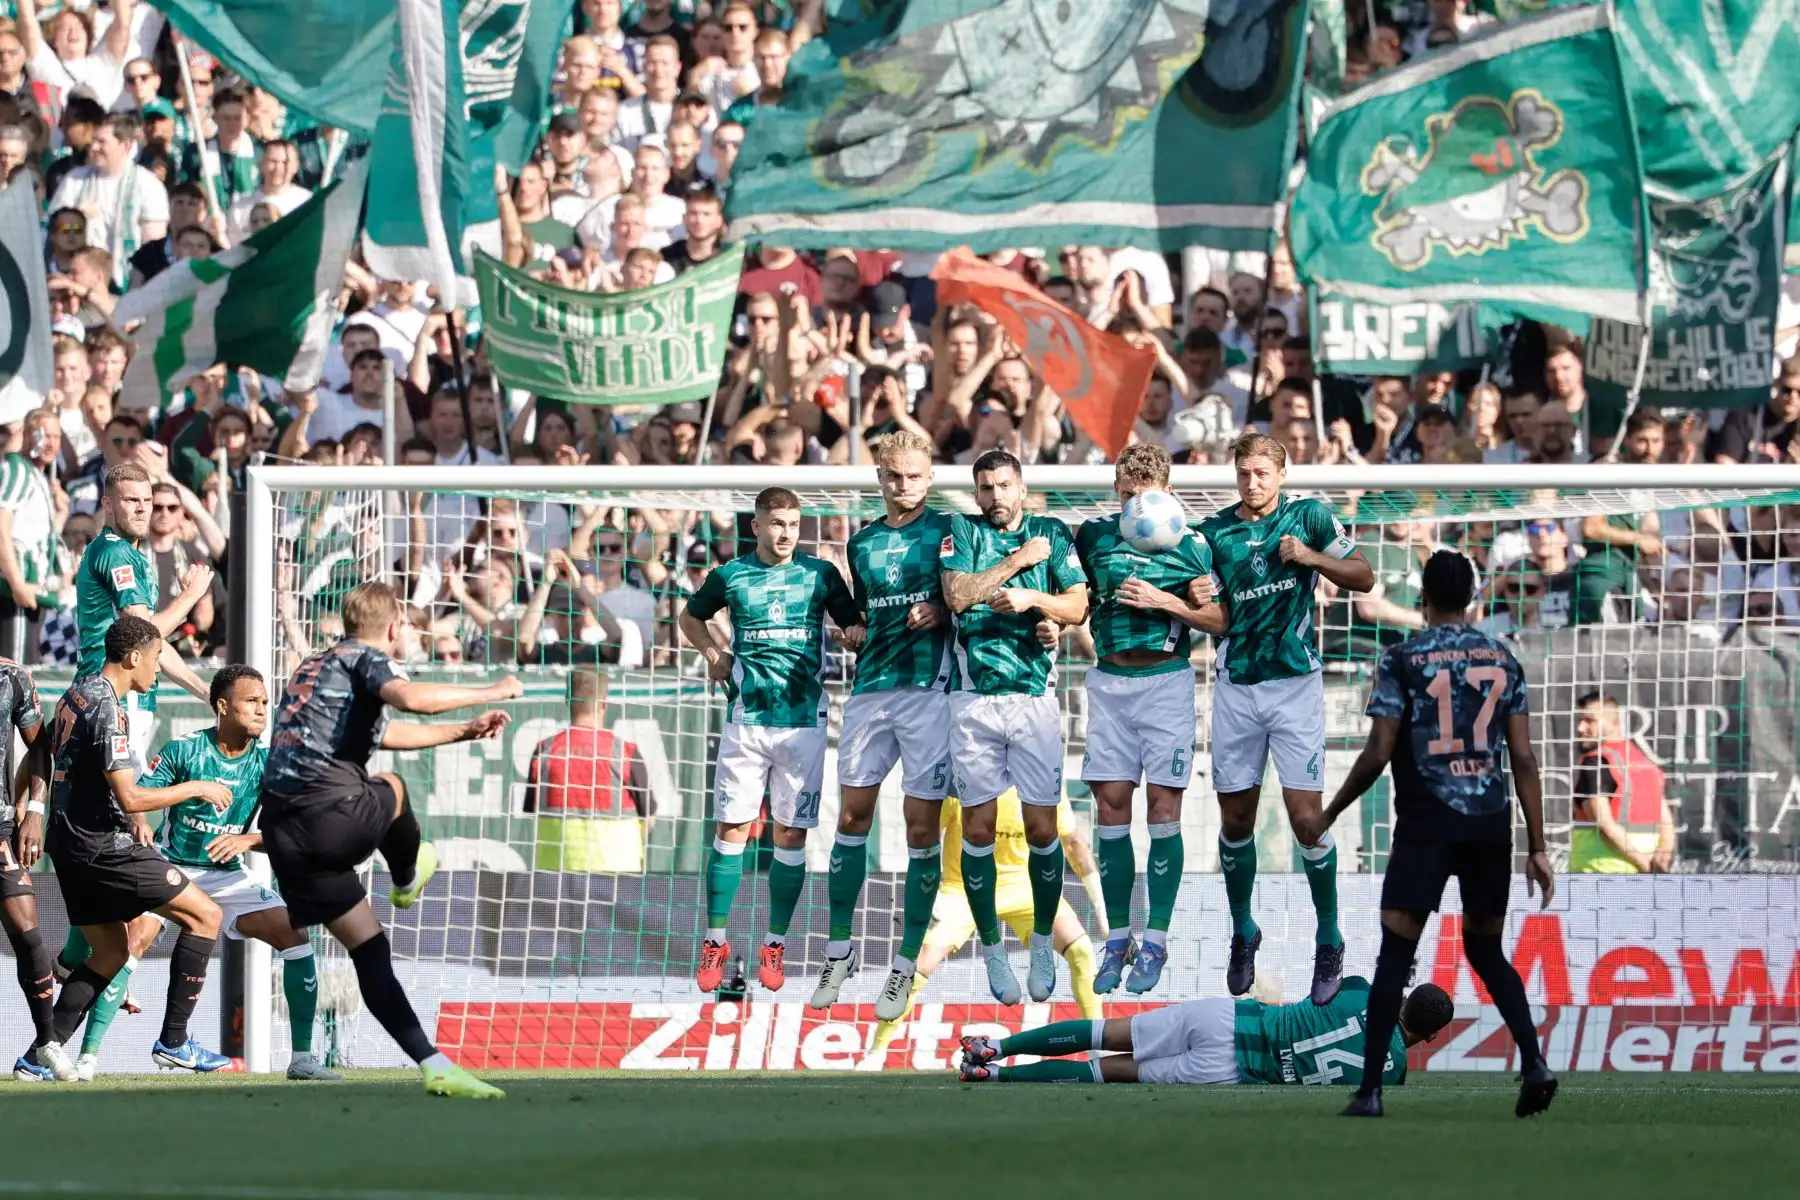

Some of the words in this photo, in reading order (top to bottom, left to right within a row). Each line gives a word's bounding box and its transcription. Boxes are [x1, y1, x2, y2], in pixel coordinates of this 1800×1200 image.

[1425, 666, 1508, 755] 17
[1618, 705, 1730, 765] RIP
[932, 762, 946, 791] 5
[1171, 748, 1185, 777] 6
[1306, 752, 1319, 781] 4
[796, 790, 821, 819] 20
[1279, 1048, 1296, 1083] LYNEN
